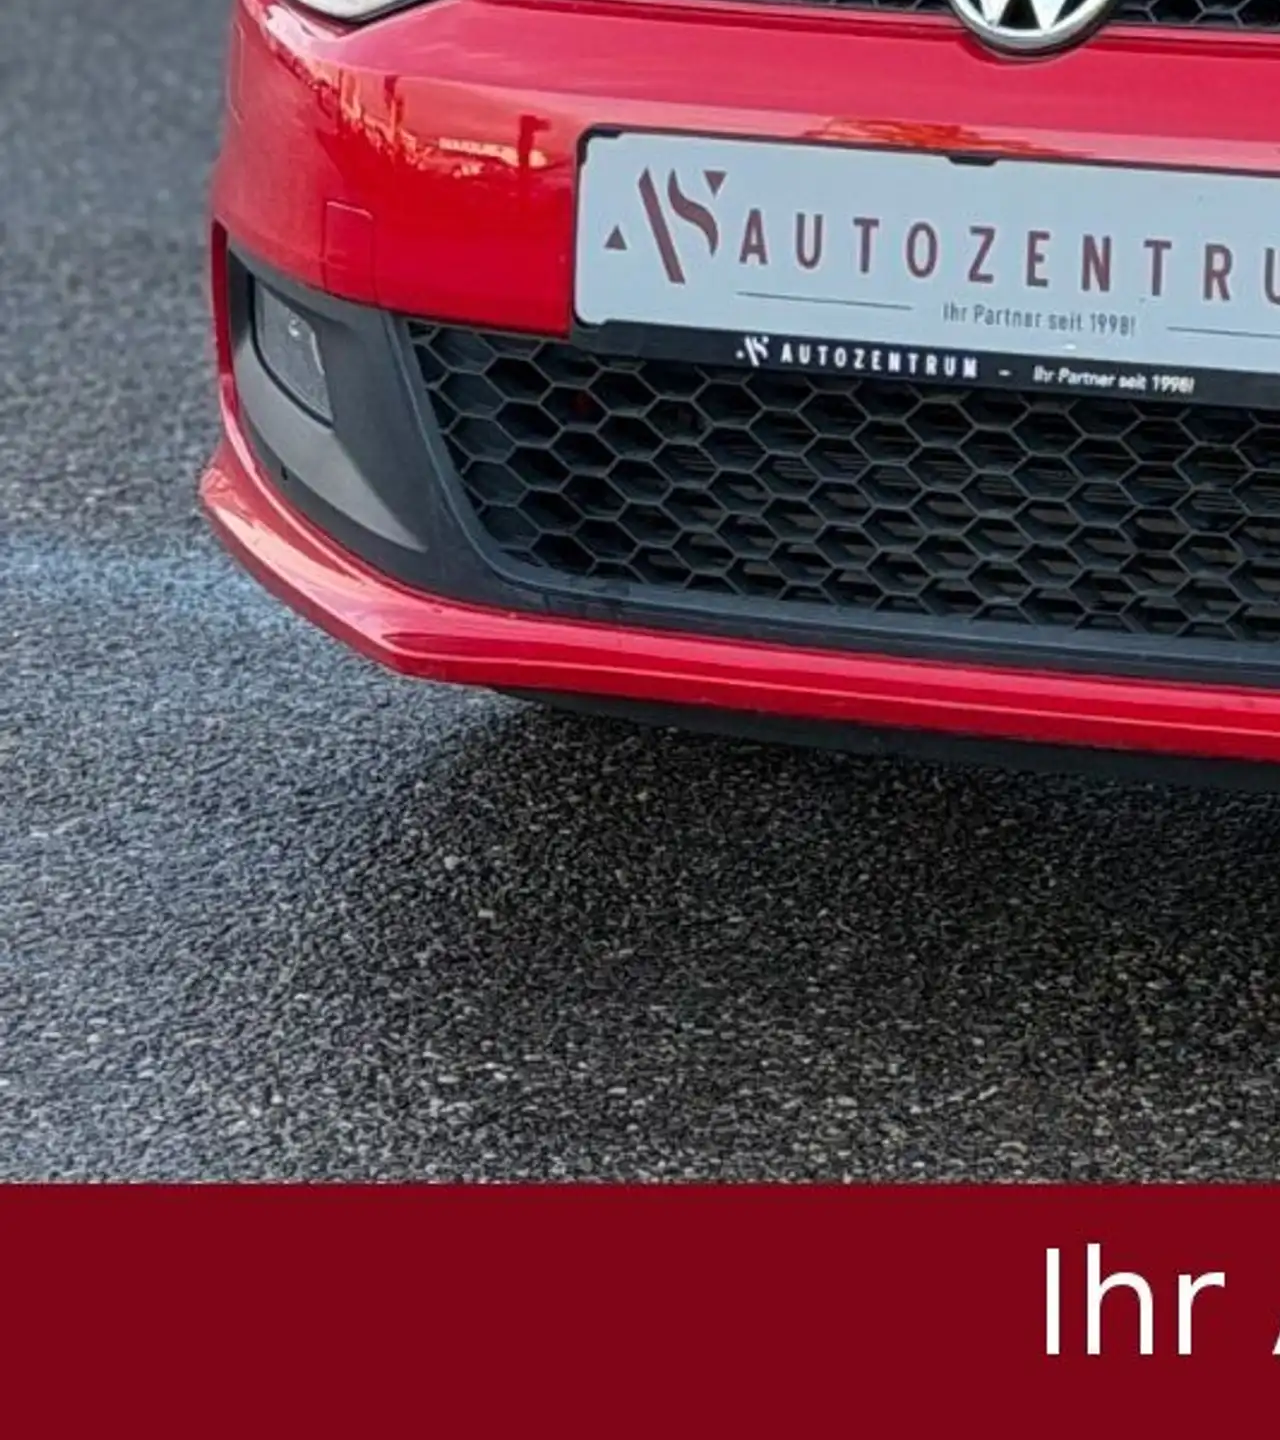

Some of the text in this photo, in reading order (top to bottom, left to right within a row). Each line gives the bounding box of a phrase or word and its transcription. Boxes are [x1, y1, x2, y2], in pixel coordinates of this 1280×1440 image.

[943, 302, 1137, 337] Ihr Partner seit 1998!
[779, 342, 978, 379] AUTOZENTRUM
[1033, 365, 1054, 384] Ihr
[1057, 367, 1116, 388] Partner
[1118, 374, 1147, 391] seit
[1151, 374, 1195, 394] 1998!
